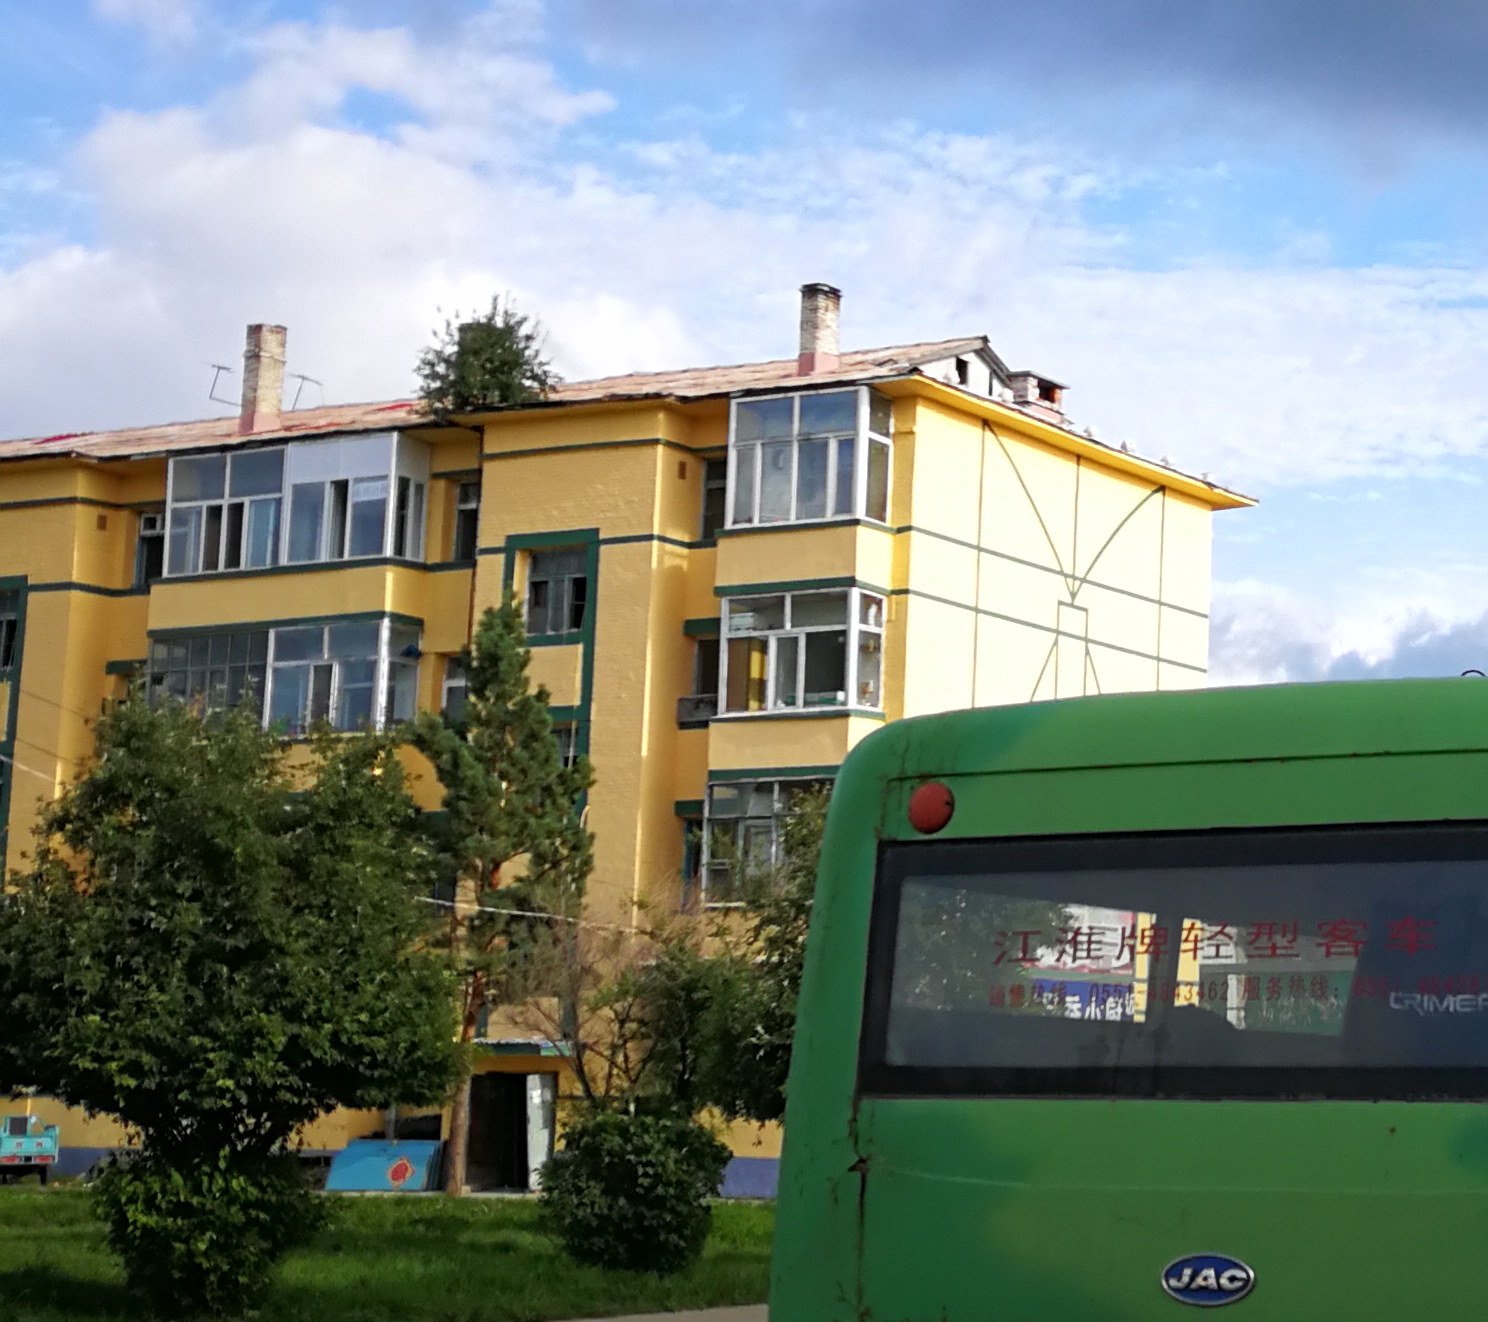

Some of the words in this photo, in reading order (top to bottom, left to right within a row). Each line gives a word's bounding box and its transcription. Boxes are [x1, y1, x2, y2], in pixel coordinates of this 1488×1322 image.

[994, 916, 1438, 965] 江淮牌轻型客车
[1168, 1267, 1248, 1292] JAC
